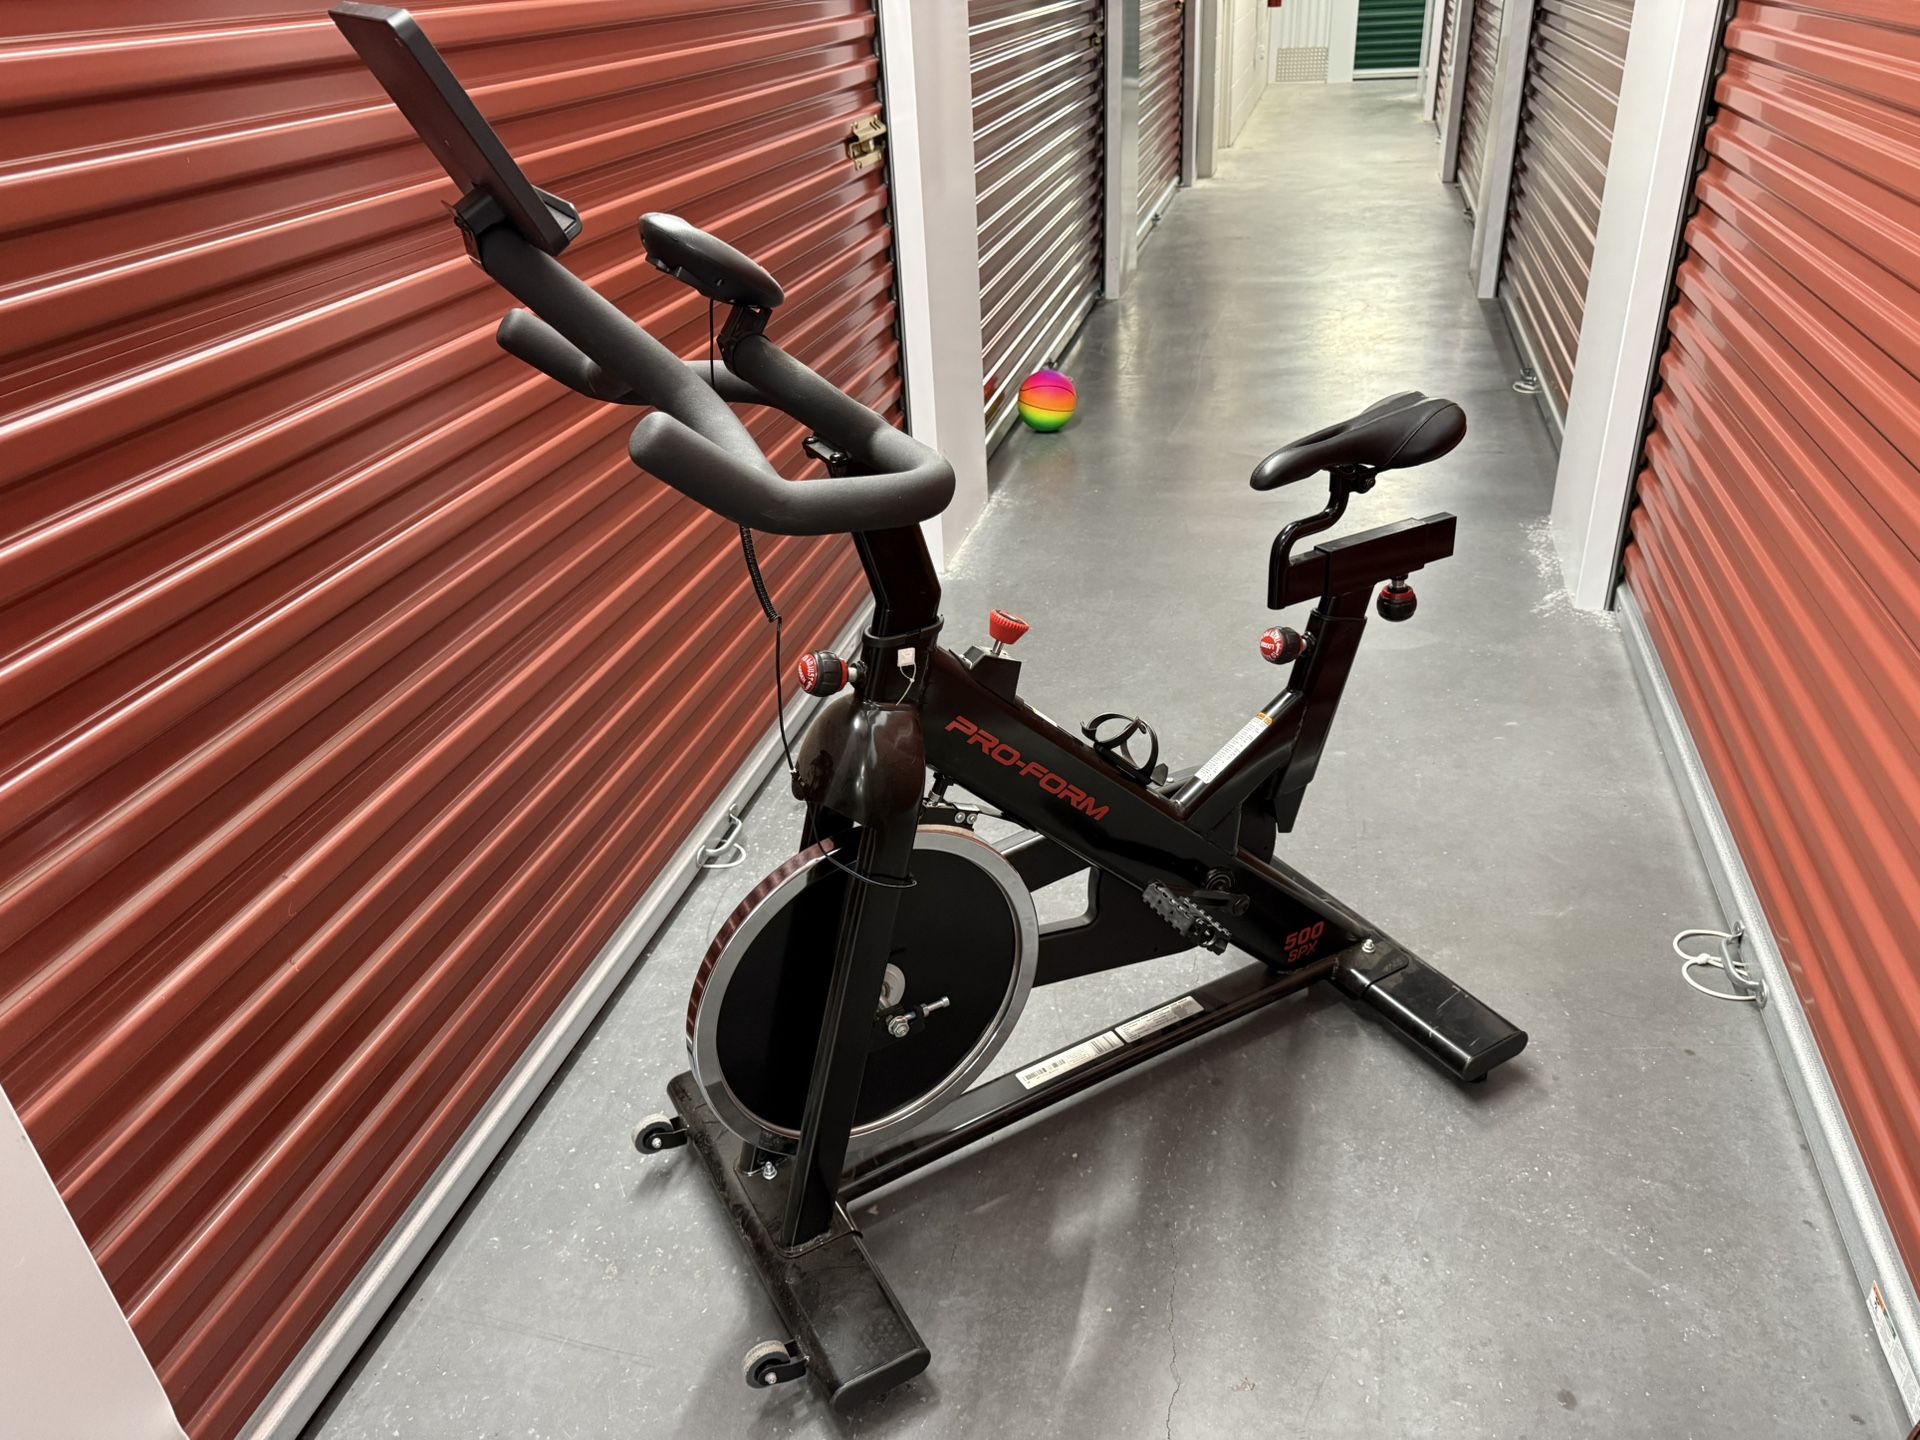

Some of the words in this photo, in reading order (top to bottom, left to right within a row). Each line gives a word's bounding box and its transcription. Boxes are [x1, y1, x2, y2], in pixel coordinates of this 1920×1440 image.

[945, 715, 1112, 822] PRO-FORM
[1284, 921, 1325, 951] 500
[1287, 940, 1319, 962] SPX
